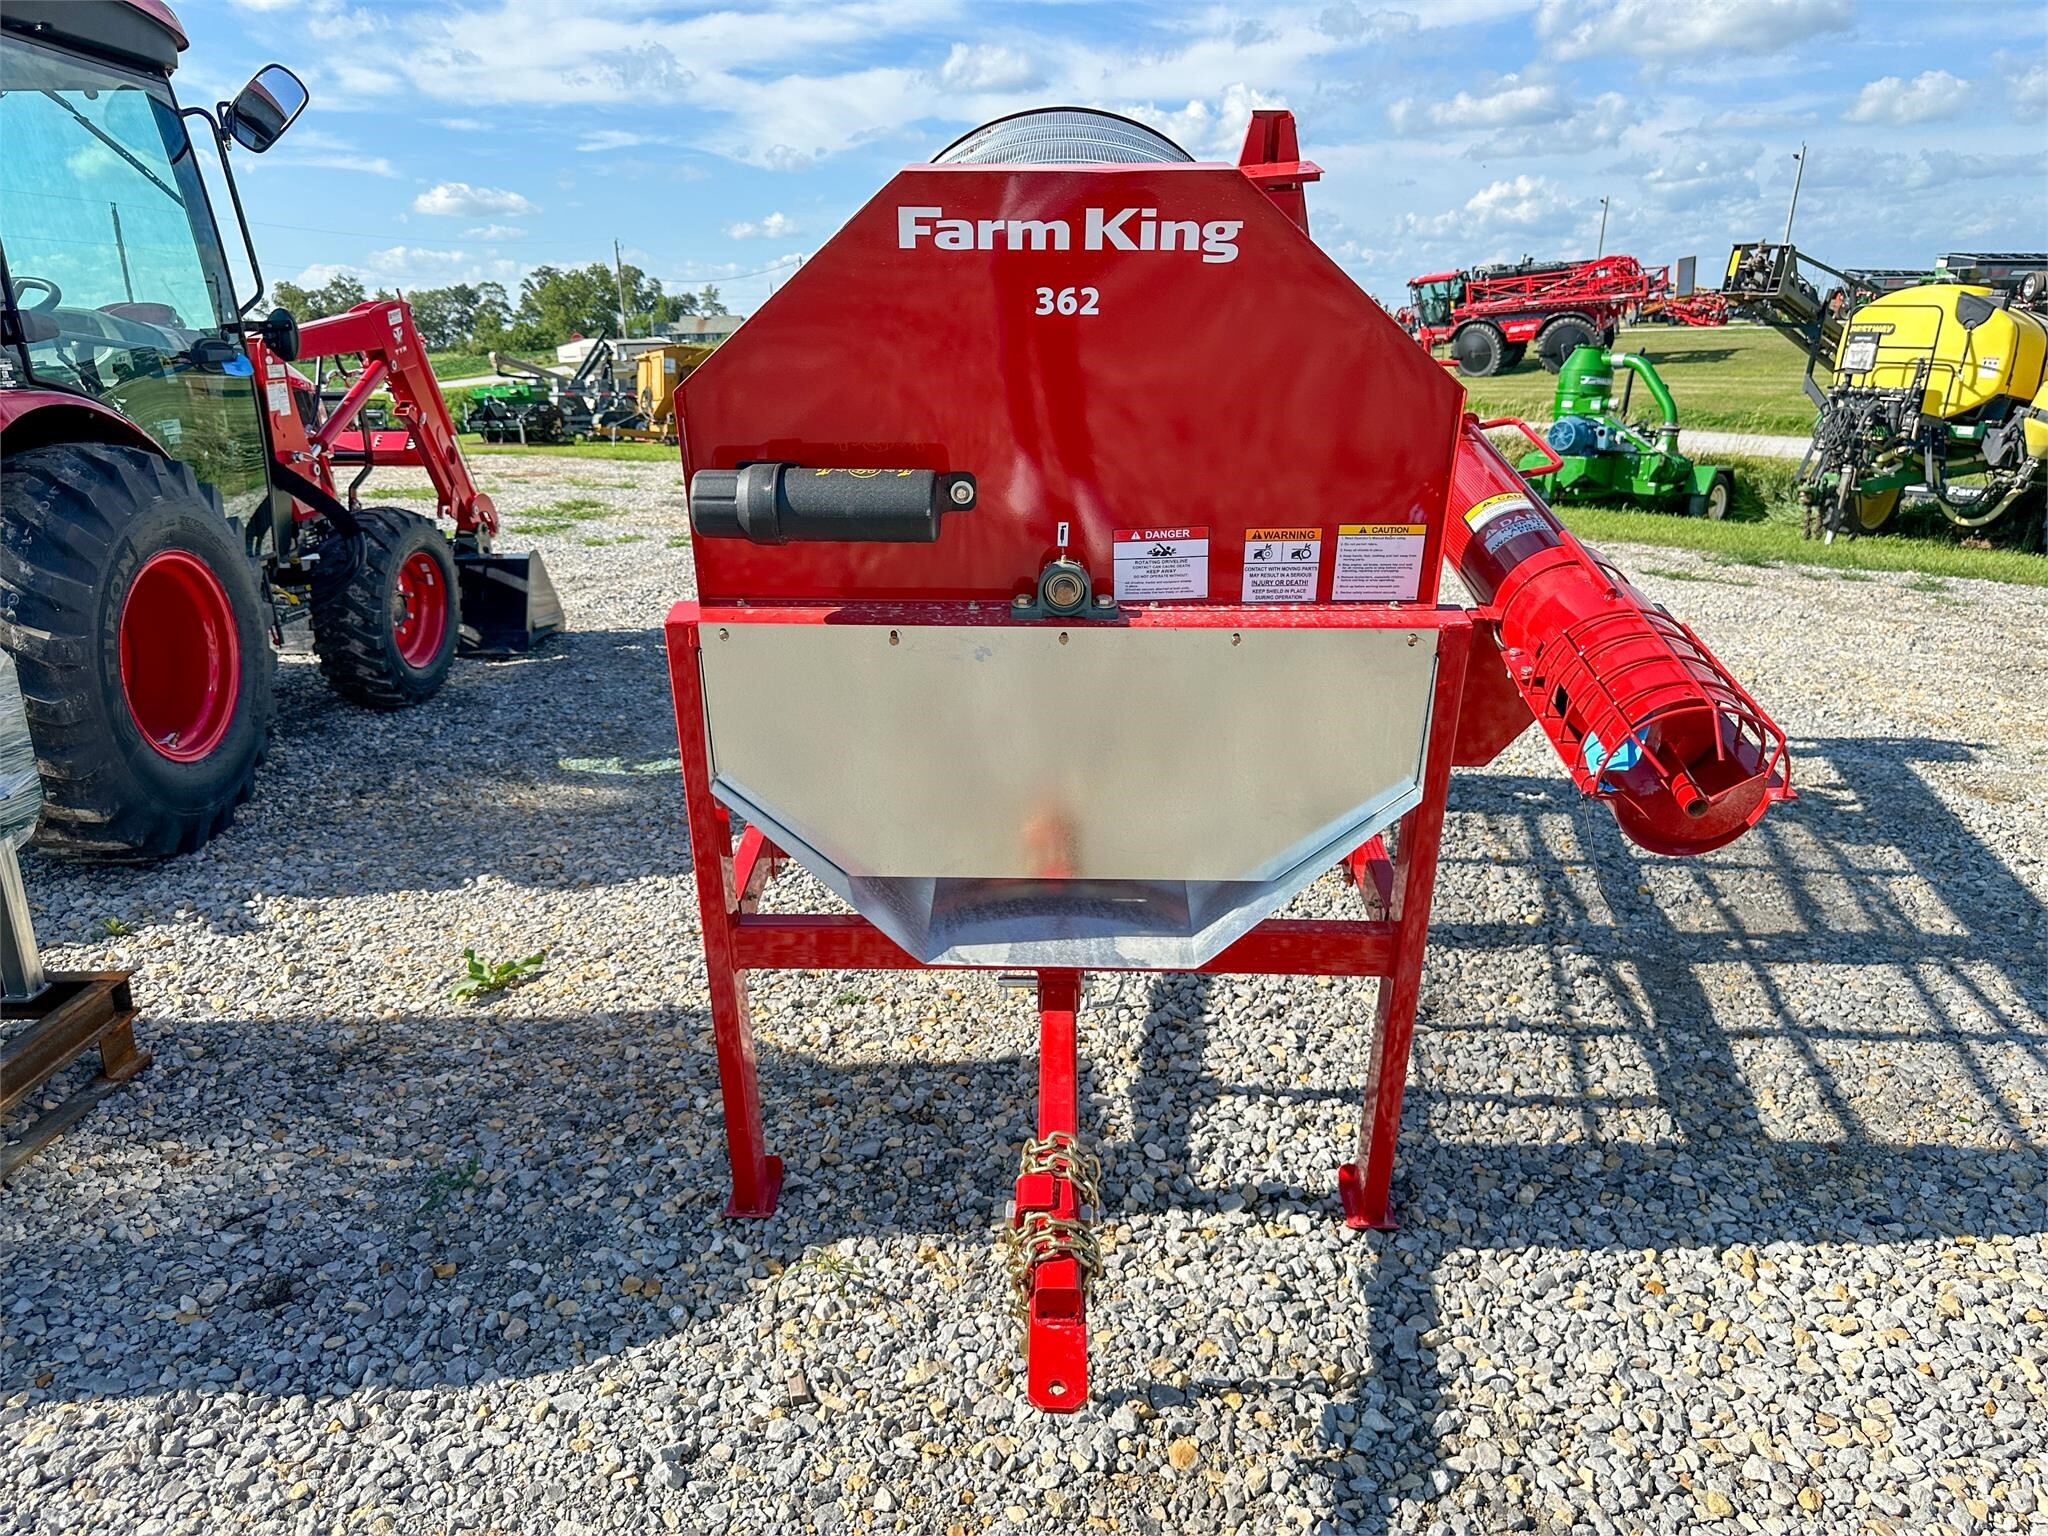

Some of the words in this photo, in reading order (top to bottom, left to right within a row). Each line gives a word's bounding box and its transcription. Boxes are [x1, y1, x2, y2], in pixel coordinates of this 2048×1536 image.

[897, 206, 1070, 251] Farm
[1085, 207, 1244, 264] King
[1035, 286, 1099, 316] 362
[1499, 513, 1539, 528] DAN
[1145, 529, 1190, 539] DANGER
[1263, 530, 1316, 539] WARNING
[1371, 526, 1409, 534] CAUTION
